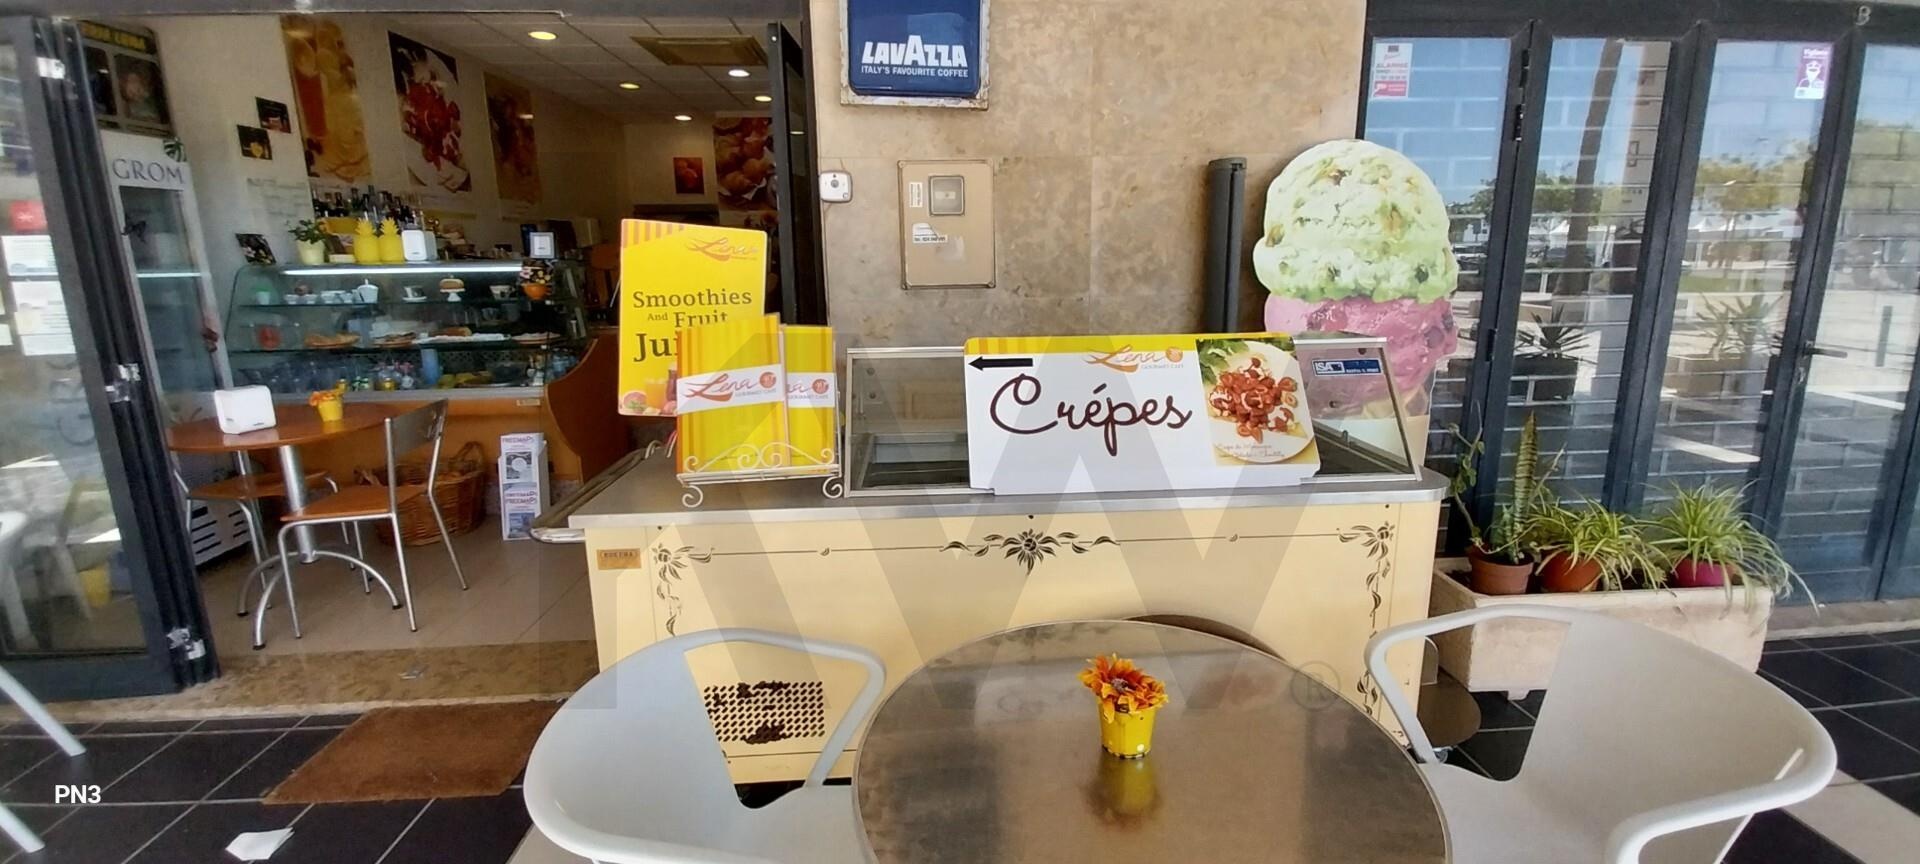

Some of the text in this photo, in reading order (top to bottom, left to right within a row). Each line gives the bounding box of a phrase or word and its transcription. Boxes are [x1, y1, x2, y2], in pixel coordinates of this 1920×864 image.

[861, 34, 968, 67] LAVAZZA
[861, 66, 968, 78] ITALY'S FAVOURITE COFFEE
[112, 158, 185, 185] GROM
[632, 288, 753, 309] Smoothies
[647, 312, 669, 321] And
[1083, 343, 1164, 373] Lena
[684, 373, 758, 402] Lena
